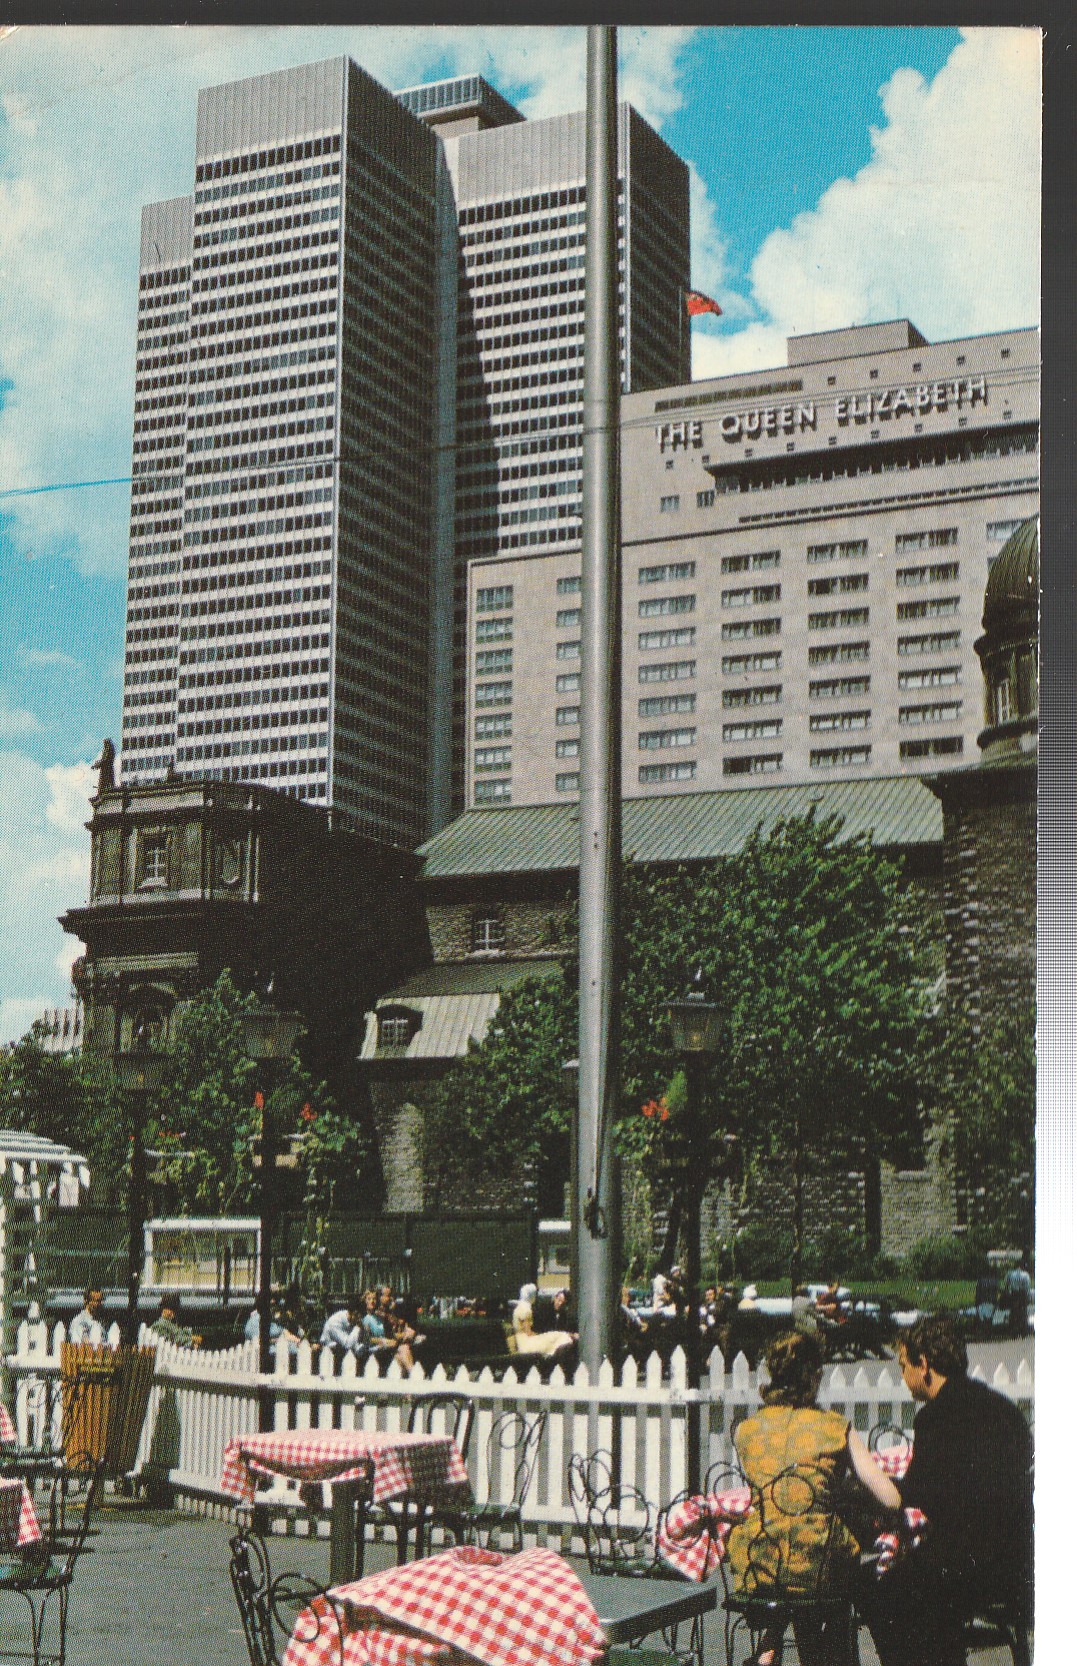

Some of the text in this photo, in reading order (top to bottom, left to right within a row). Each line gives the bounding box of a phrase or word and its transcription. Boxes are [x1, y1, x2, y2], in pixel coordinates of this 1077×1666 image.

[655, 378, 987, 447] THE QUEEN ELIZABETH
